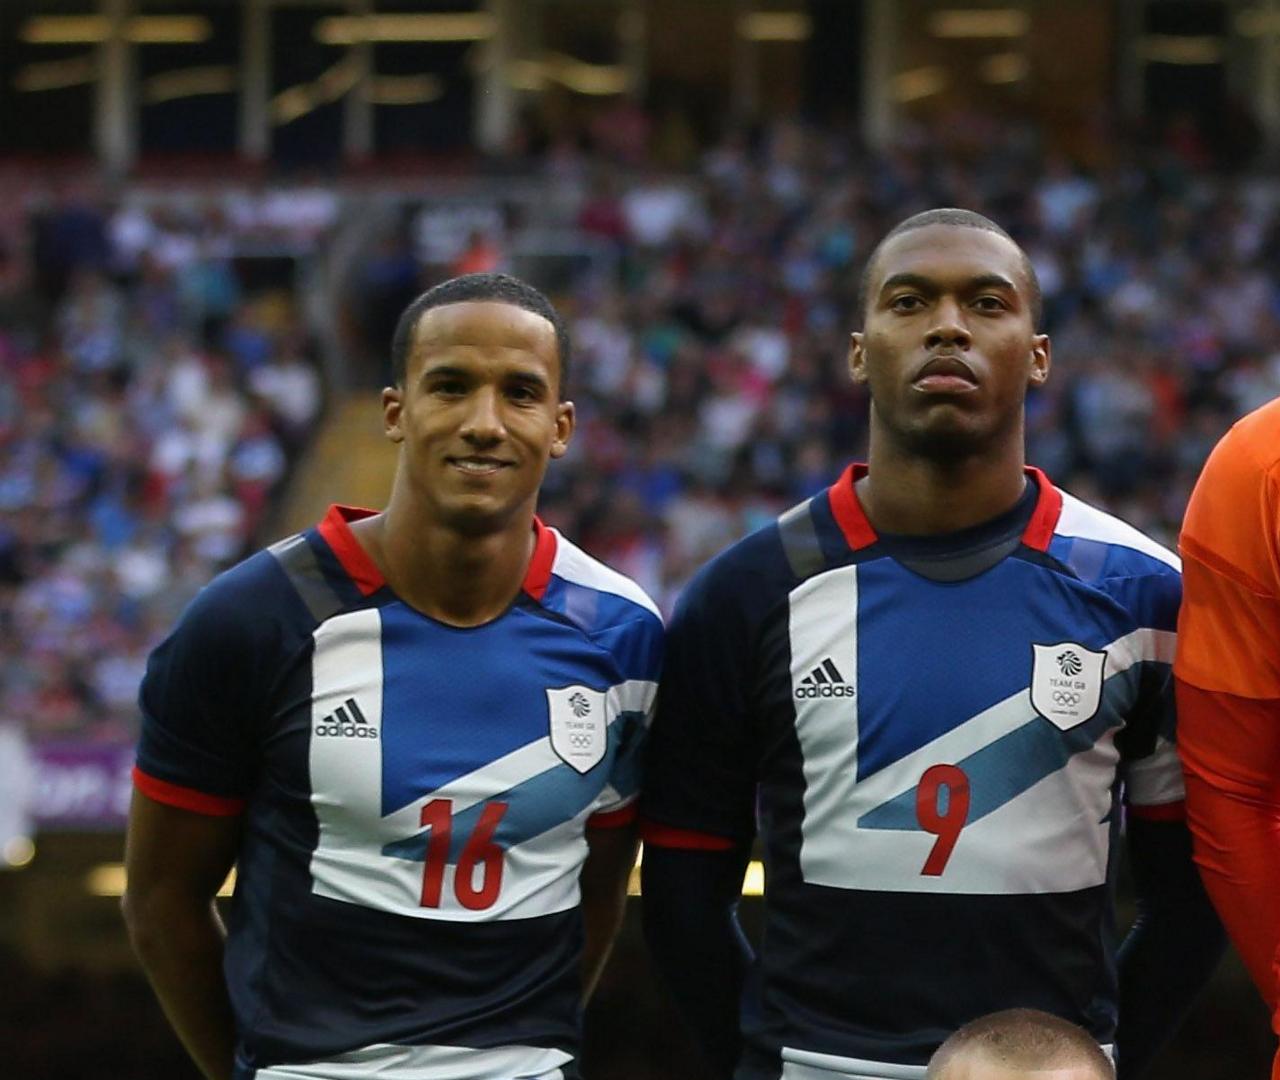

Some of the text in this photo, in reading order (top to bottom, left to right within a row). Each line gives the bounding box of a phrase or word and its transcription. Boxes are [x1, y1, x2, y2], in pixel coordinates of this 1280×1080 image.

[795, 683, 855, 699] adidas
[1050, 678, 1085, 690] TEAM GB
[316, 725, 377, 739] adidas
[915, 764, 970, 876] 9
[420, 799, 508, 911] 16
